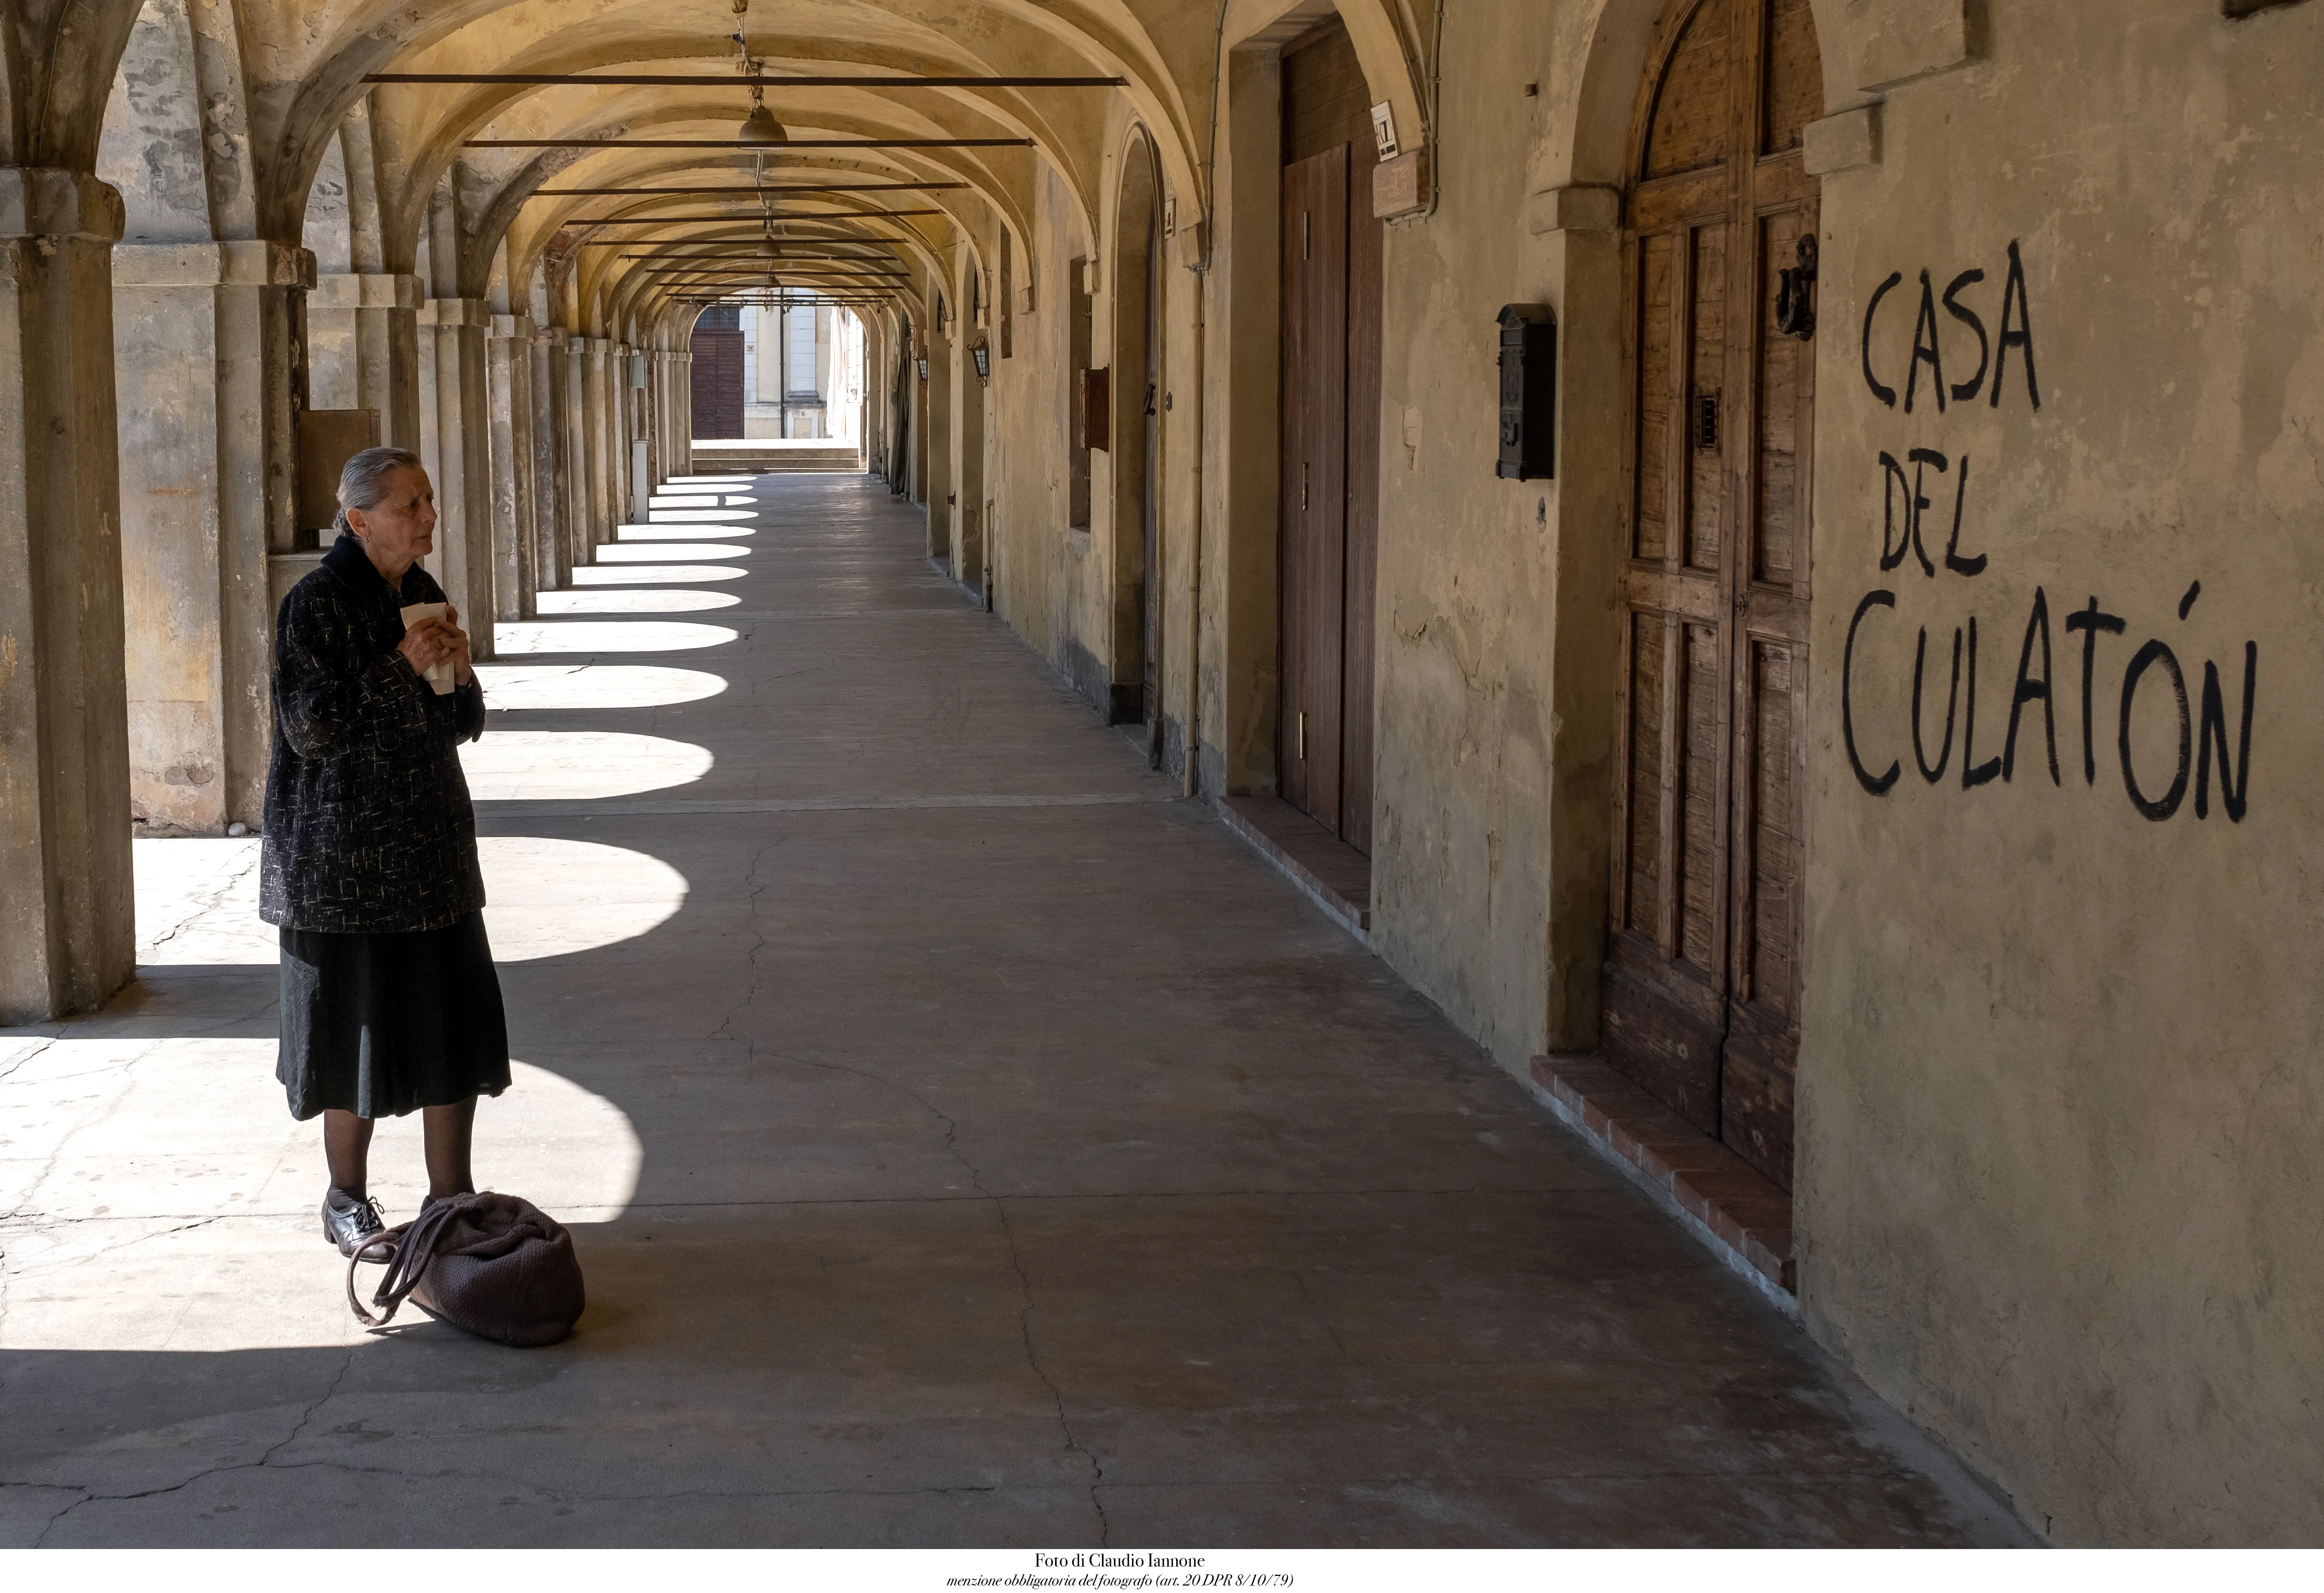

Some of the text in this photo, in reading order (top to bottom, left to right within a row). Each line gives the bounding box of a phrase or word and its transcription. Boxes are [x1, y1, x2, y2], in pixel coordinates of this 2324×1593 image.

[1861, 238, 2041, 414] CASA
[1879, 448, 1988, 578] DEL
[1842, 579, 2257, 824] CULATÓN
